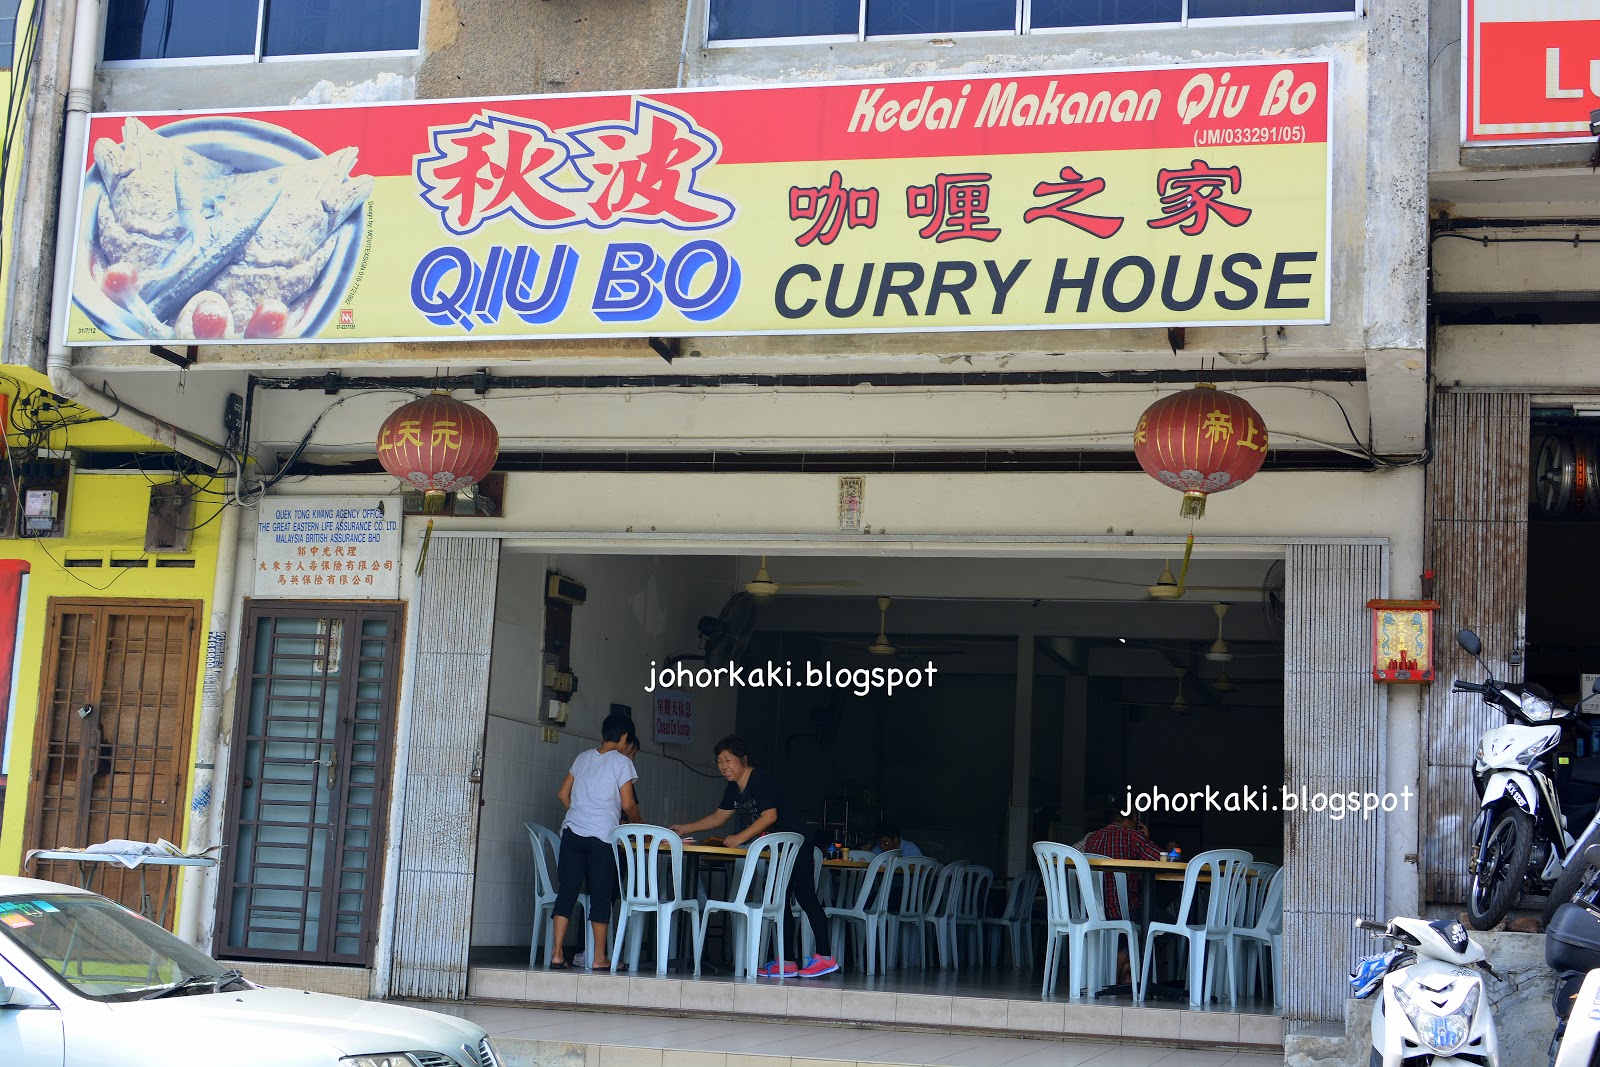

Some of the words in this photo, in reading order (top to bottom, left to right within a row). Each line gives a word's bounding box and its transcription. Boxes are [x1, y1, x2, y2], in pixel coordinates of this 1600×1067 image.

[848, 84, 970, 133] Kedai
[974, 79, 1161, 129] Makanan
[1177, 71, 1248, 125] Qiu
[1260, 69, 1317, 117] Bo
[434, 110, 708, 226] 秋波
[1193, 124, 1307, 148] (JM/033291/05)
[787, 159, 1252, 248] 咖喱之家
[410, 243, 580, 331] QIU
[592, 239, 741, 323] BO
[774, 258, 1031, 320] CURRY
[1045, 250, 1318, 315] HOUSE
[258, 522, 270, 532] THE
[272, 522, 291, 532] GREAT
[293, 521, 319, 532] EASTERN
[321, 521, 333, 531] LIFE
[335, 521, 372, 531] ASSURANCE
[275, 509, 292, 520] QUEK
[294, 509, 311, 520] TONG
[312, 509, 334, 519] KWANG
[335, 509, 360, 519] AGENCY
[362, 508, 384, 519] OFFICE
[275, 533, 304, 544] MALAYSIA
[305, 533, 328, 543] BRITISH
[329, 533, 366, 543] ASSURANCE
[368, 533, 381, 542] BHD
